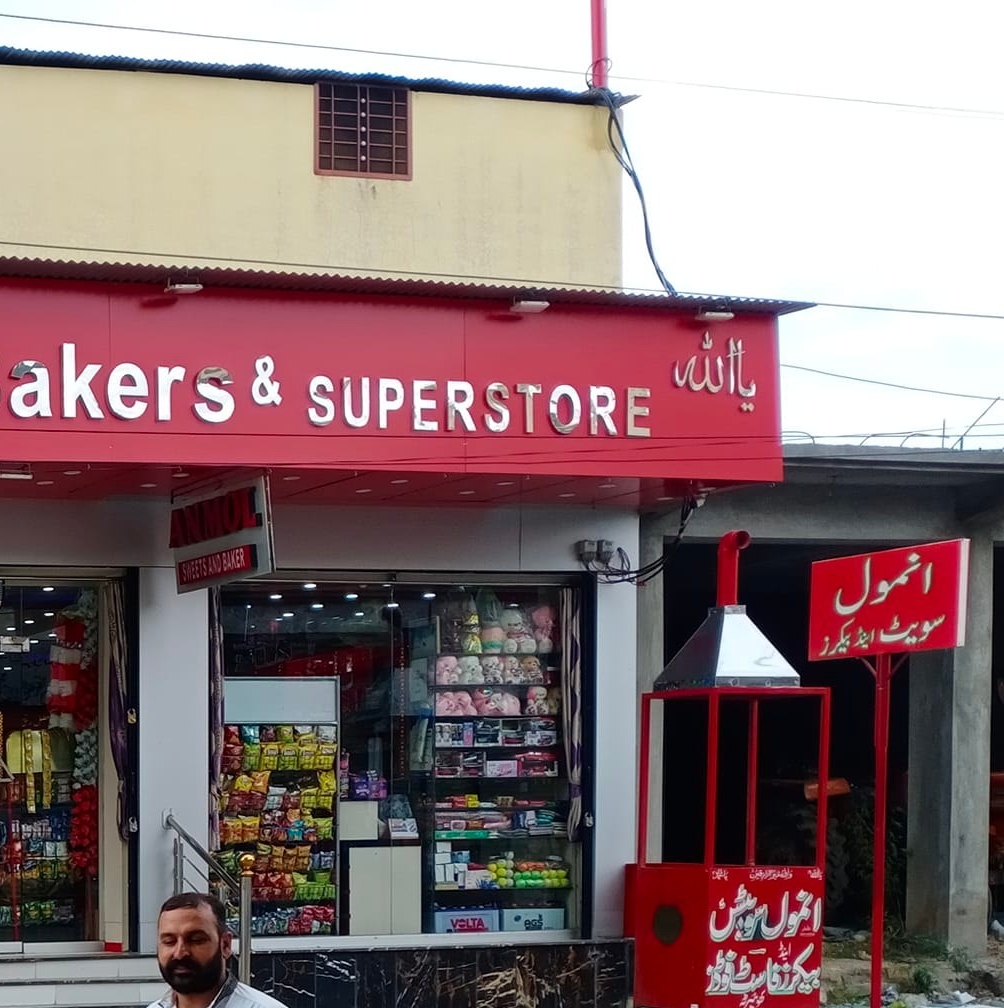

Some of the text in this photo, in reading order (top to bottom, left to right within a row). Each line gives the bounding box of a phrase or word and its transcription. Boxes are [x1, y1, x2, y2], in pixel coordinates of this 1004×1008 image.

[251, 354, 282, 408] &
[307, 374, 652, 438] SUPERSTORE
[169, 487, 262, 549] ANMOL
[181, 547, 246, 582] SWEETS AND BAKER
[834, 551, 933, 616] انمول
[819, 614, 946, 657] سویٹ اینڈ بیکرز
[450, 917, 486, 929] VOLTA
[760, 888, 822, 941] انمول
